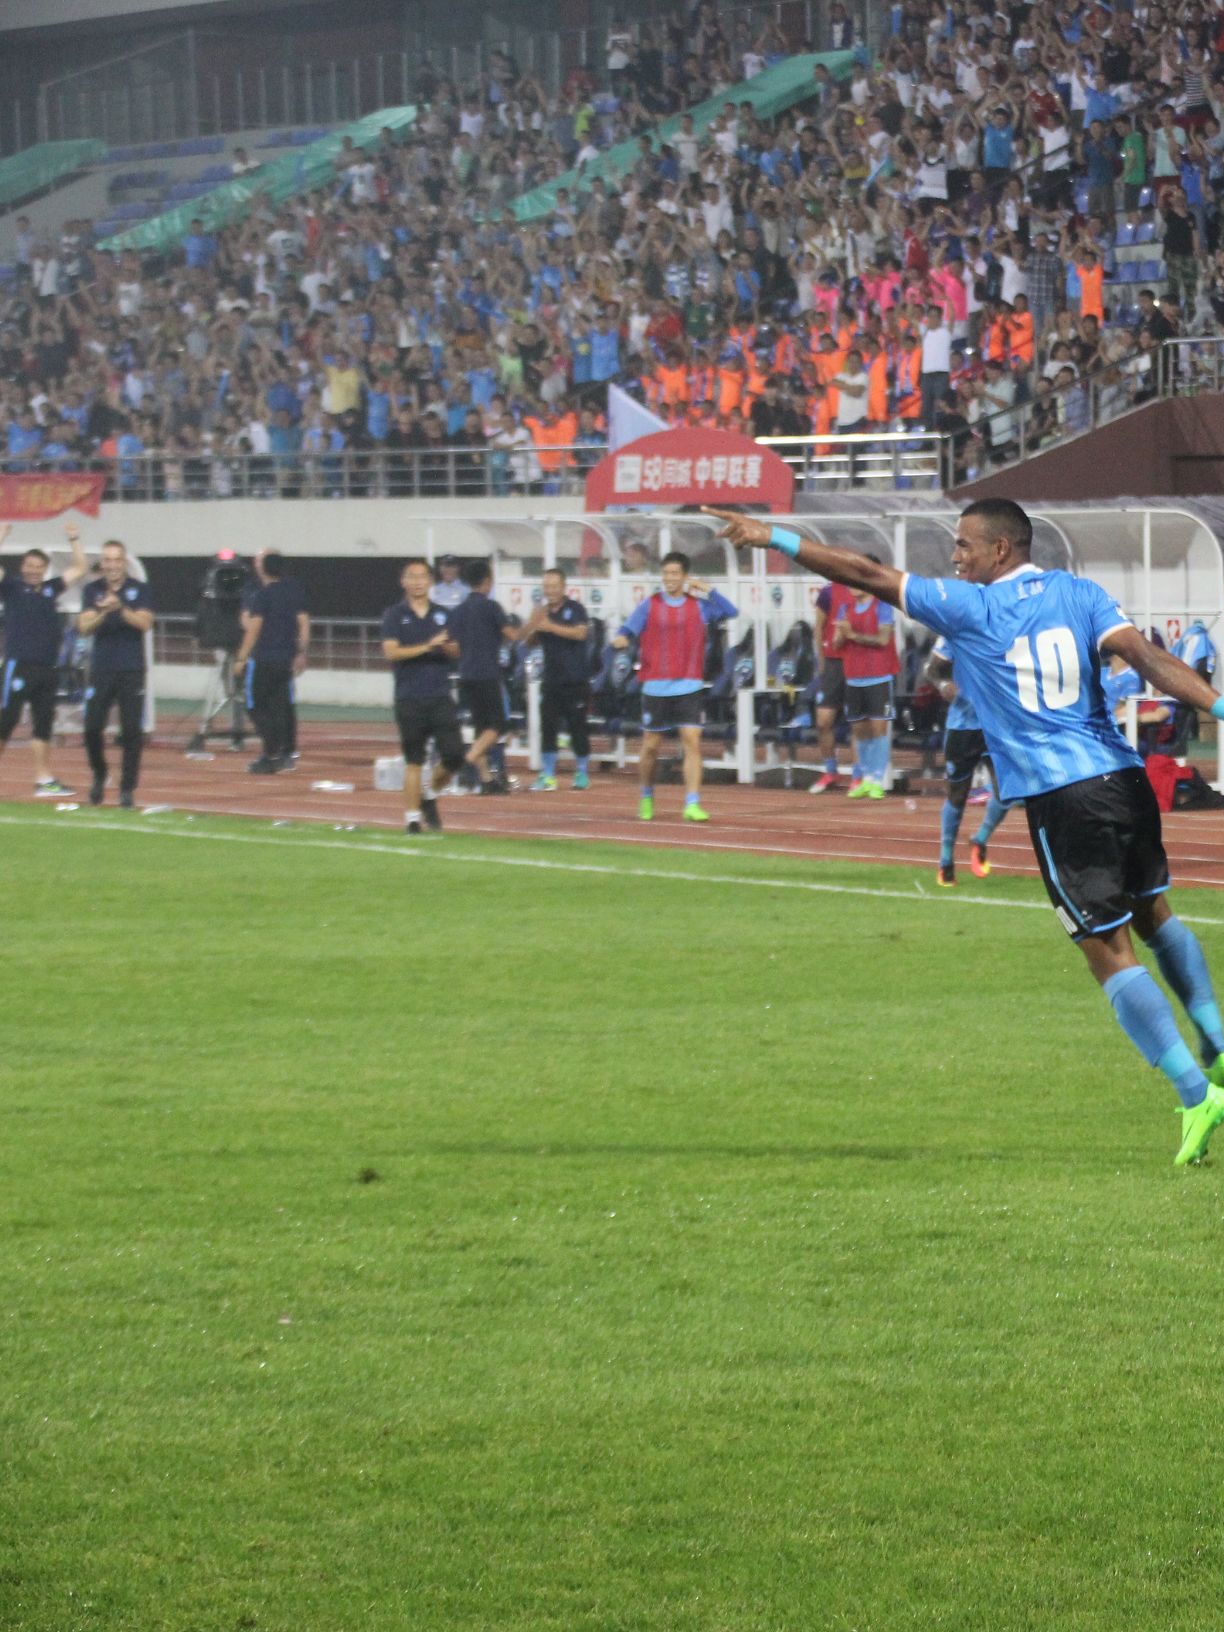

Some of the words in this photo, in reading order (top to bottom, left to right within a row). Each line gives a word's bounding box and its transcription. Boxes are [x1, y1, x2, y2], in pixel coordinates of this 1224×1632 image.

[695, 454, 763, 489] 中甲联赛
[1006, 626, 1080, 712] 10
